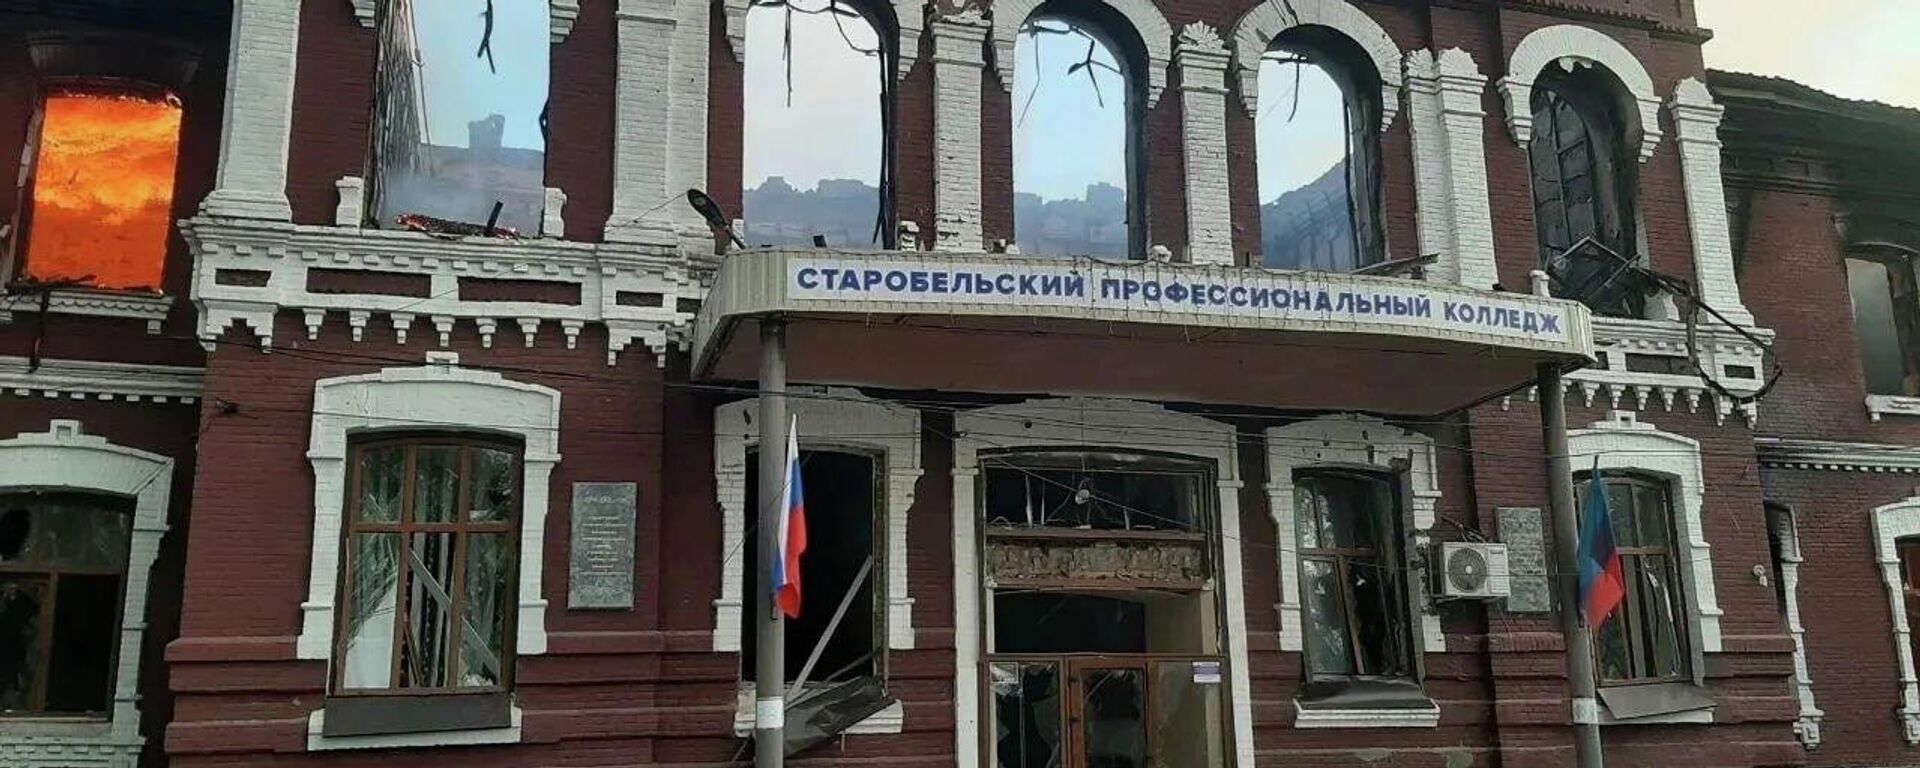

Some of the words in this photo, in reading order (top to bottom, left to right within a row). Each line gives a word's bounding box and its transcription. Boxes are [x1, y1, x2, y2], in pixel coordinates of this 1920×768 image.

[797, 268, 1084, 297] СТАРОБЕЛЬСКИЙ
[1101, 278, 1431, 318] ПРОФЕССИОНАЛЬНЫЙ
[1444, 302, 1560, 334] КОЛЛЕДЖ
